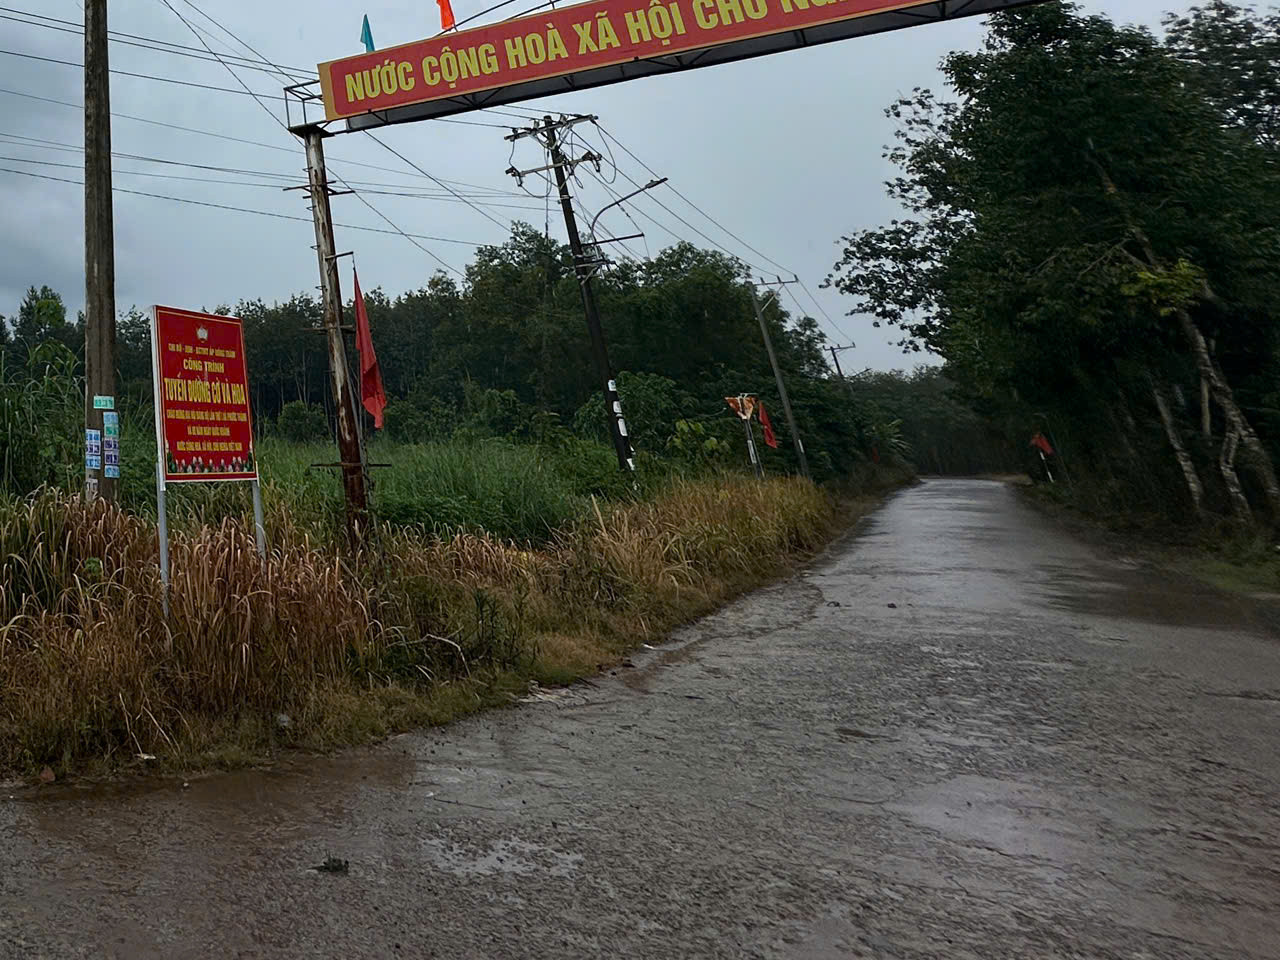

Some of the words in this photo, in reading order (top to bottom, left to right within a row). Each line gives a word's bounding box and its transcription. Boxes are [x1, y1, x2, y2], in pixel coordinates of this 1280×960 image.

[344, 60, 415, 102] NƯỚC
[422, 42, 499, 89] CỘNG
[505, 22, 569, 69] HOÀ
[572, 10, 621, 54] XÃ
[625, 0, 686, 46] HỘI
